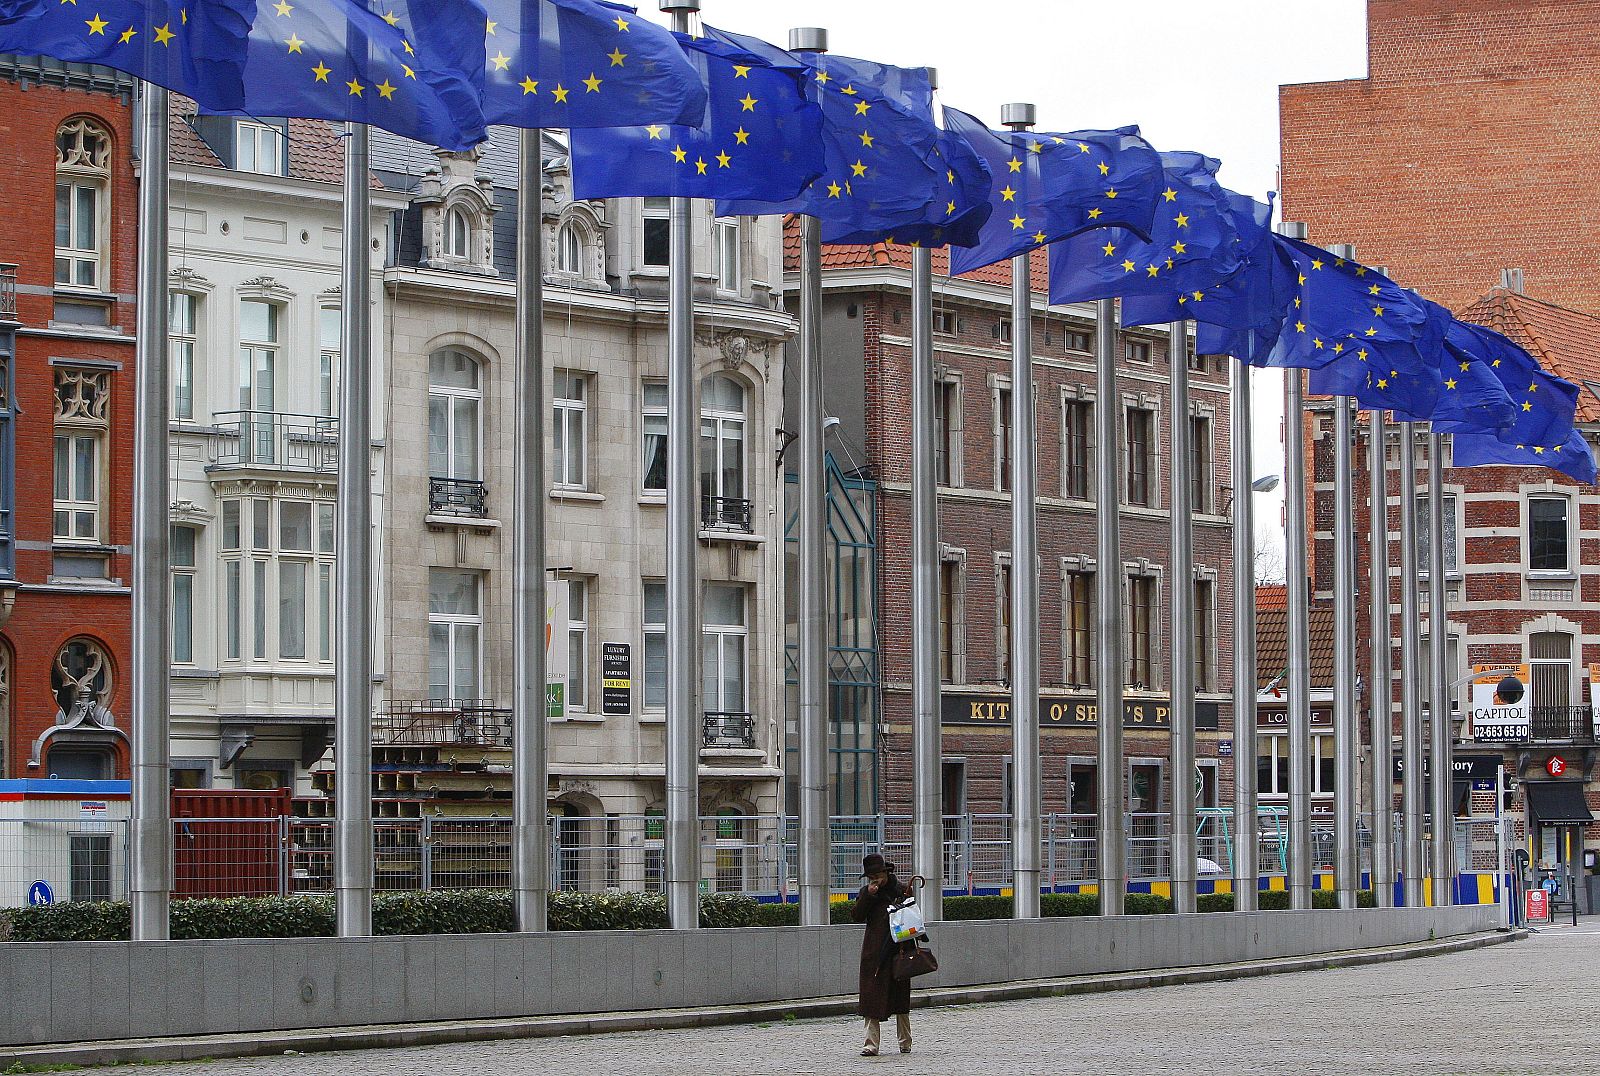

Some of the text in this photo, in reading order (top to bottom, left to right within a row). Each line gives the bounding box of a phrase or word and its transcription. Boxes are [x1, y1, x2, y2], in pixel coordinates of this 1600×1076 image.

[970, 702, 1009, 720] KIT
[1075, 704, 1144, 723] SH'S
[1475, 708, 1527, 719] CAPITOL
[1475, 725, 1528, 738] 02-663 65 80
[1451, 760, 1474, 774] tory
